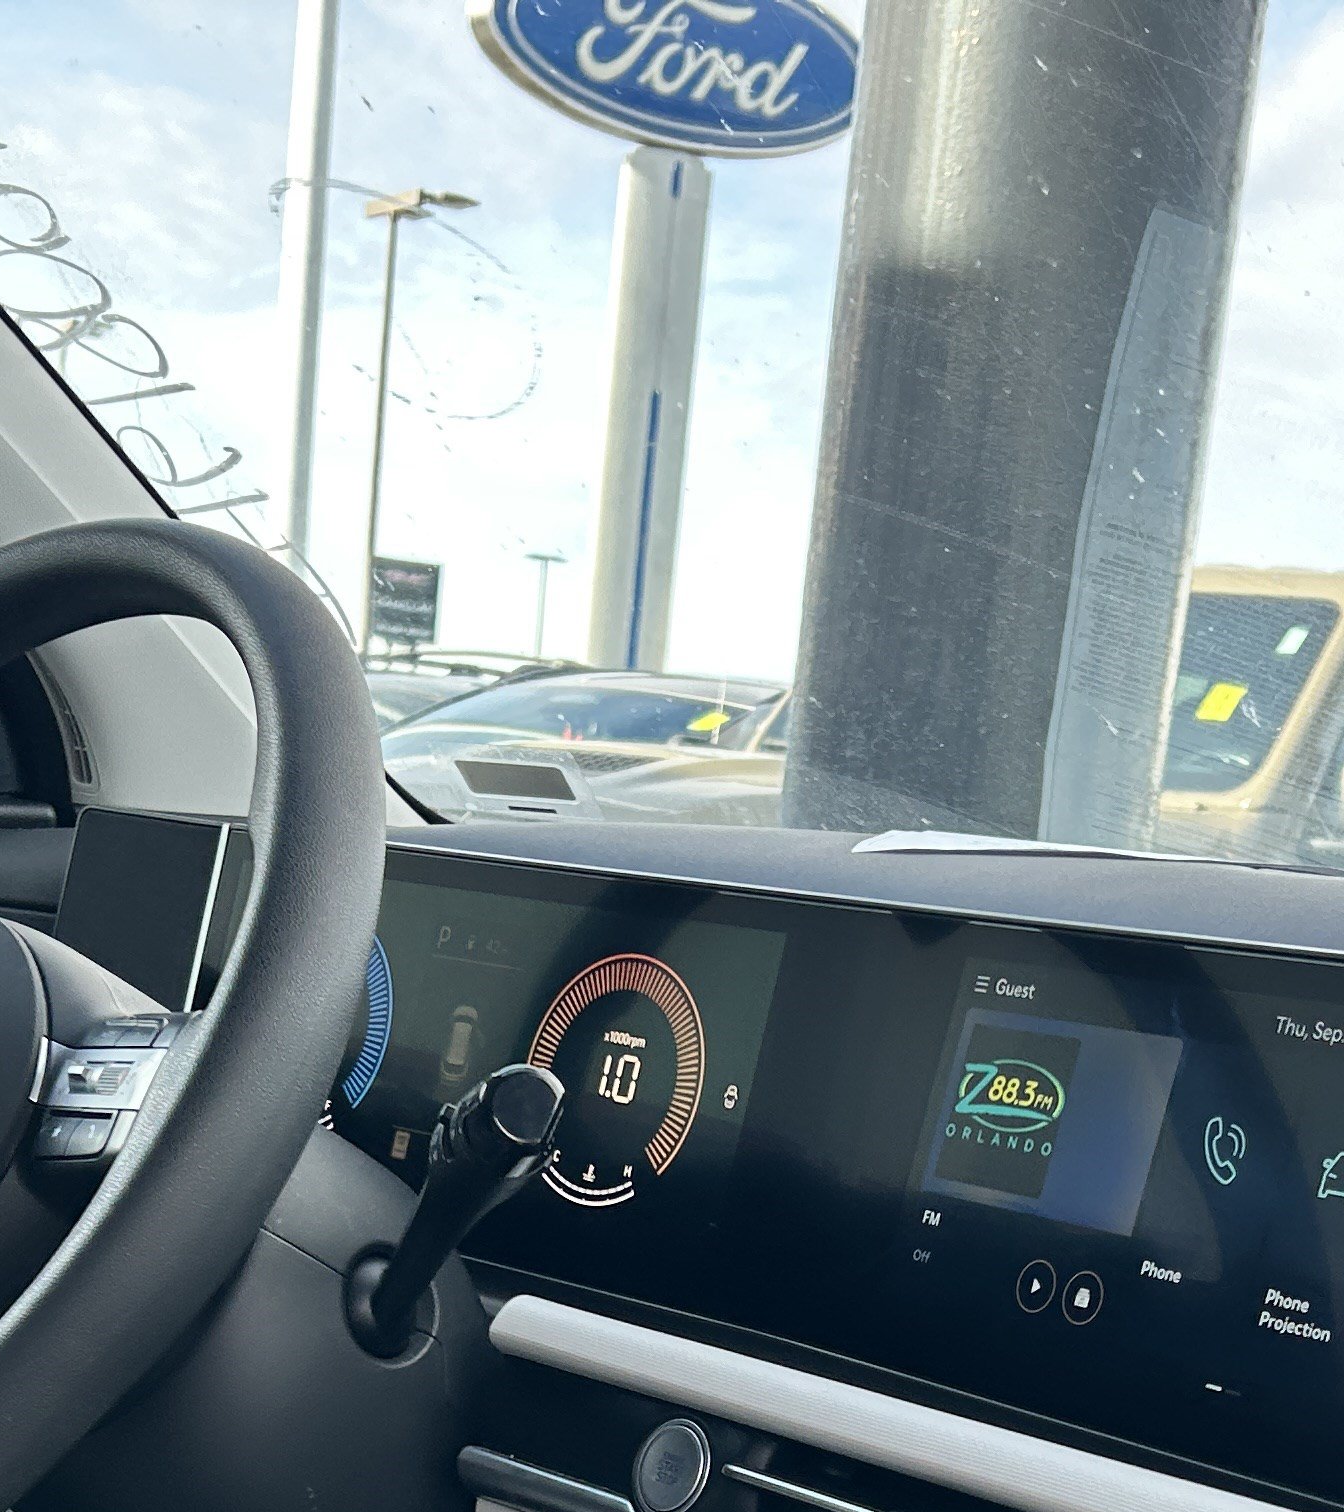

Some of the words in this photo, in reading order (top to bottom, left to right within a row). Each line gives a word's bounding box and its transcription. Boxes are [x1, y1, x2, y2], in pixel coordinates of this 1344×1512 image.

[575, 0, 810, 118] Ford
[995, 978, 1036, 1000] Guest
[1276, 1015, 1309, 1042] Thu,
[945, 1122, 1053, 1156] ORLANDO
[921, 1209, 942, 1228] FM
[912, 1248, 932, 1265] Off
[1140, 1259, 1183, 1285] Phone
[1264, 1288, 1310, 1314] Phone
[1257, 1311, 1331, 1344] Projection
